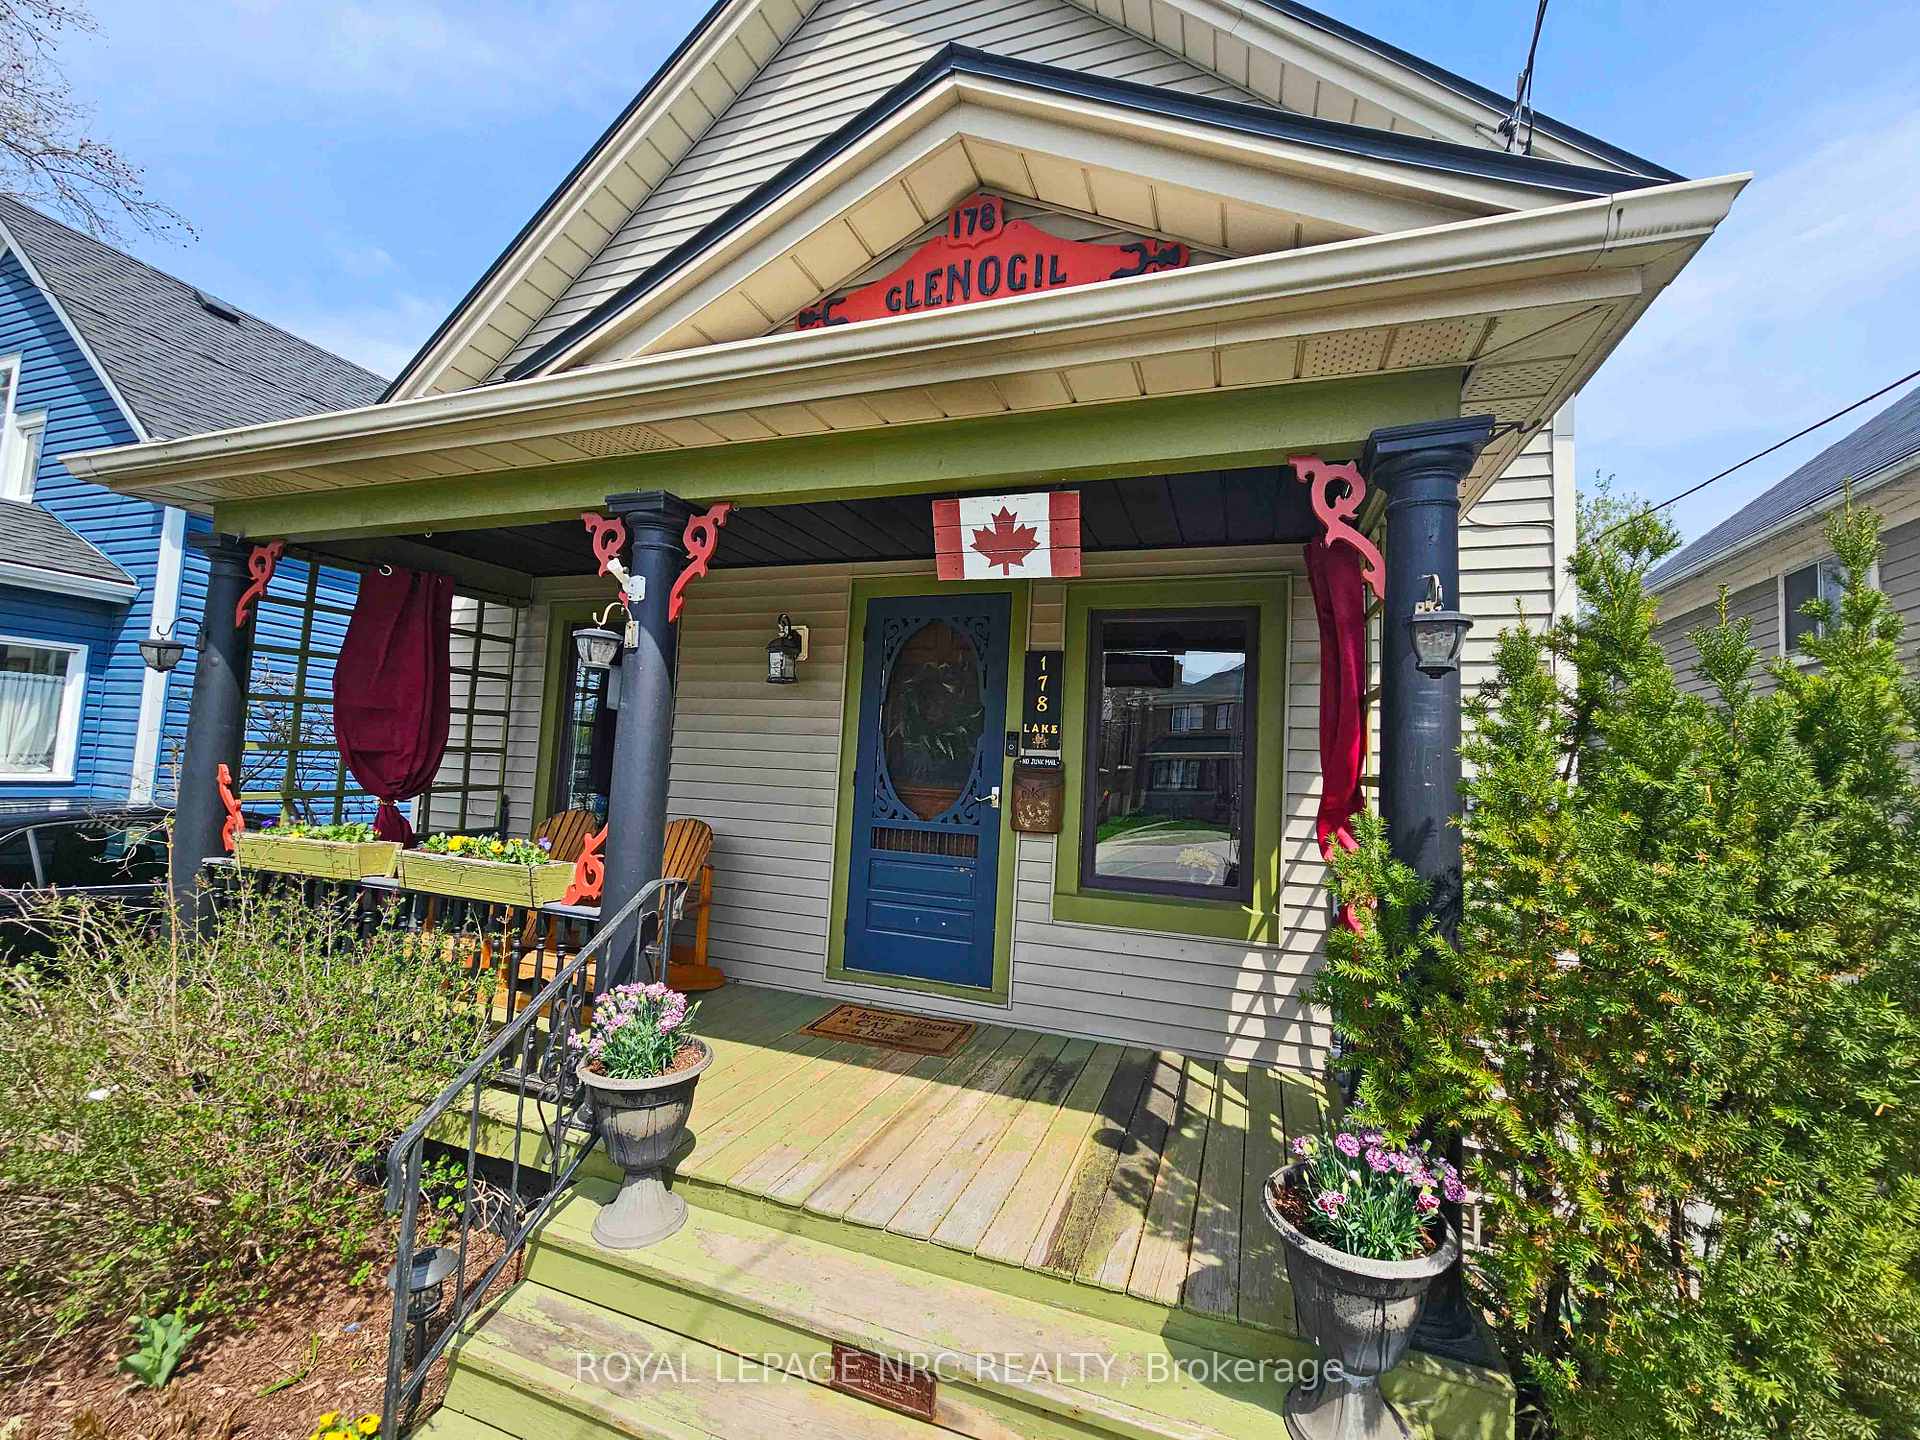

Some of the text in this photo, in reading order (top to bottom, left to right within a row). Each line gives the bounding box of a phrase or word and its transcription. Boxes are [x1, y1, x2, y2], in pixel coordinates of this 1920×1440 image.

[953, 202, 996, 239] 178
[885, 253, 1068, 312] GLENOGIL
[1023, 723, 1059, 735] LAKE
[1030, 758, 1045, 766] JUNK
